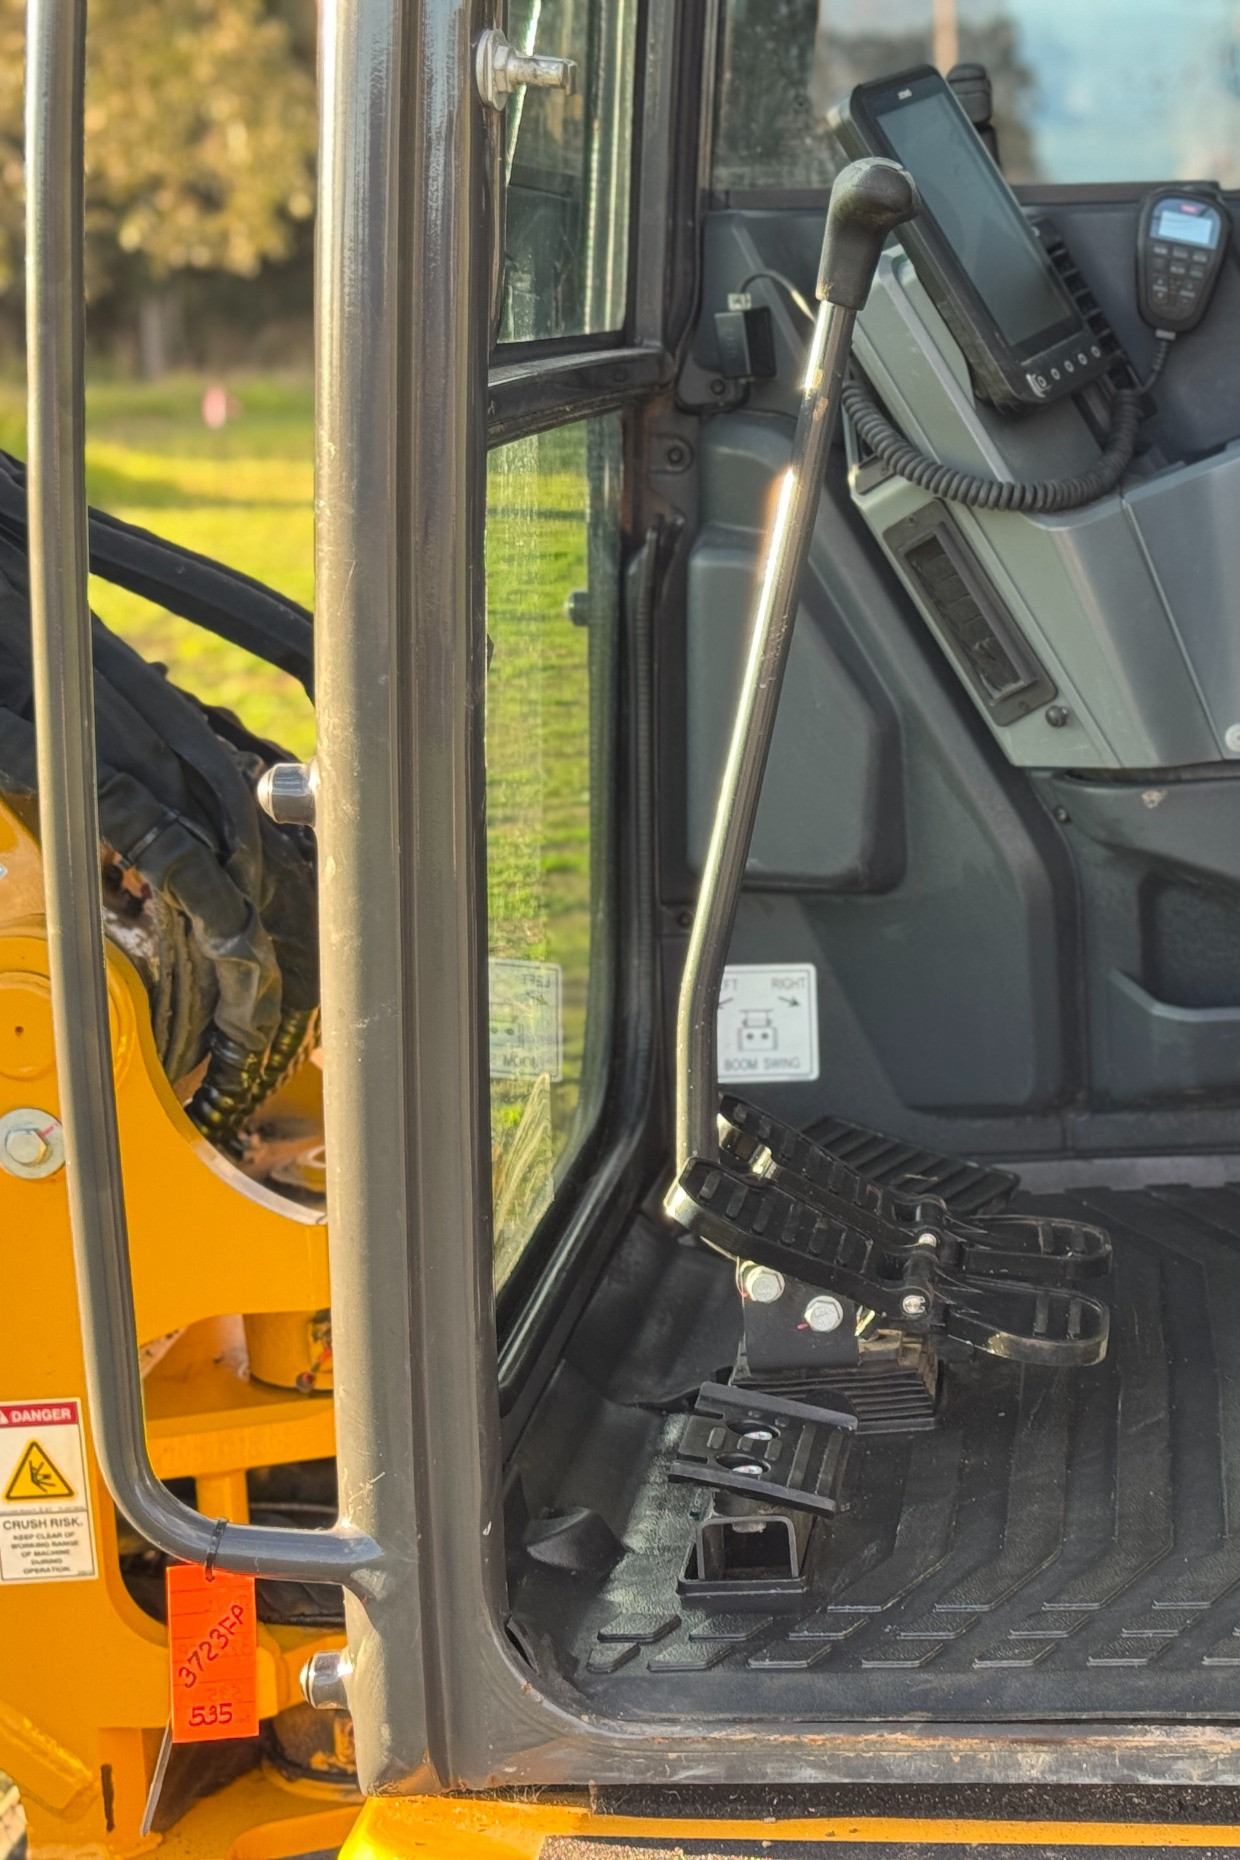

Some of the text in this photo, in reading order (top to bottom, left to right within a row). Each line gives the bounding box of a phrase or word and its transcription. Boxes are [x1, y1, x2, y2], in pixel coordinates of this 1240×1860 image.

[771, 976, 806, 991] RIGHT
[723, 1056, 800, 1071] BOOM SWING
[11, 1408, 72, 1424] DANGER
[2, 1518, 48, 1531] CRUSH
[179, 1604, 244, 1688] 3723FP
[188, 1702, 233, 1726] 535
